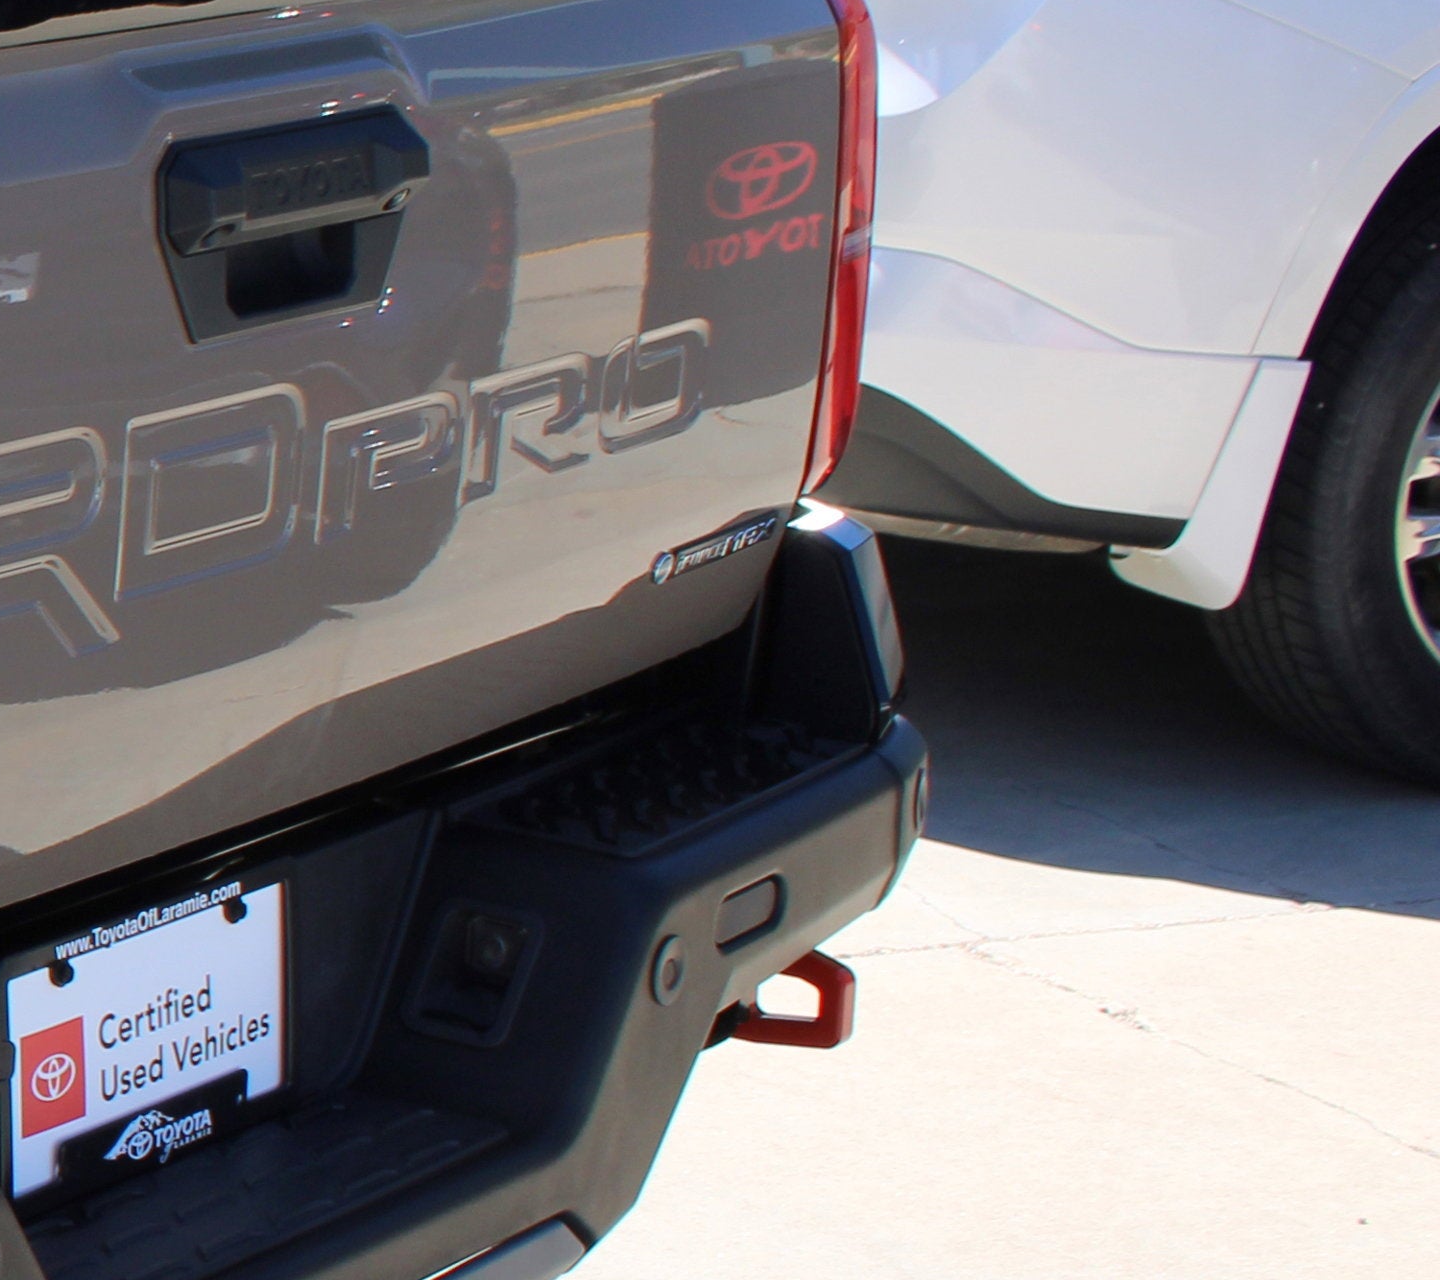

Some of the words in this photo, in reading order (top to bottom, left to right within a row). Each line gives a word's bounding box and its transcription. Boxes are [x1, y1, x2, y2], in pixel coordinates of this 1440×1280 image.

[250, 152, 371, 210] TOYOTA
[54, 880, 242, 960] www.ToyotaOfLaramie.com
[98, 973, 212, 1050] Certified
[100, 1044, 164, 1102] Used
[172, 1012, 271, 1073] Vehicles
[154, 1109, 213, 1148] TOYOTA
